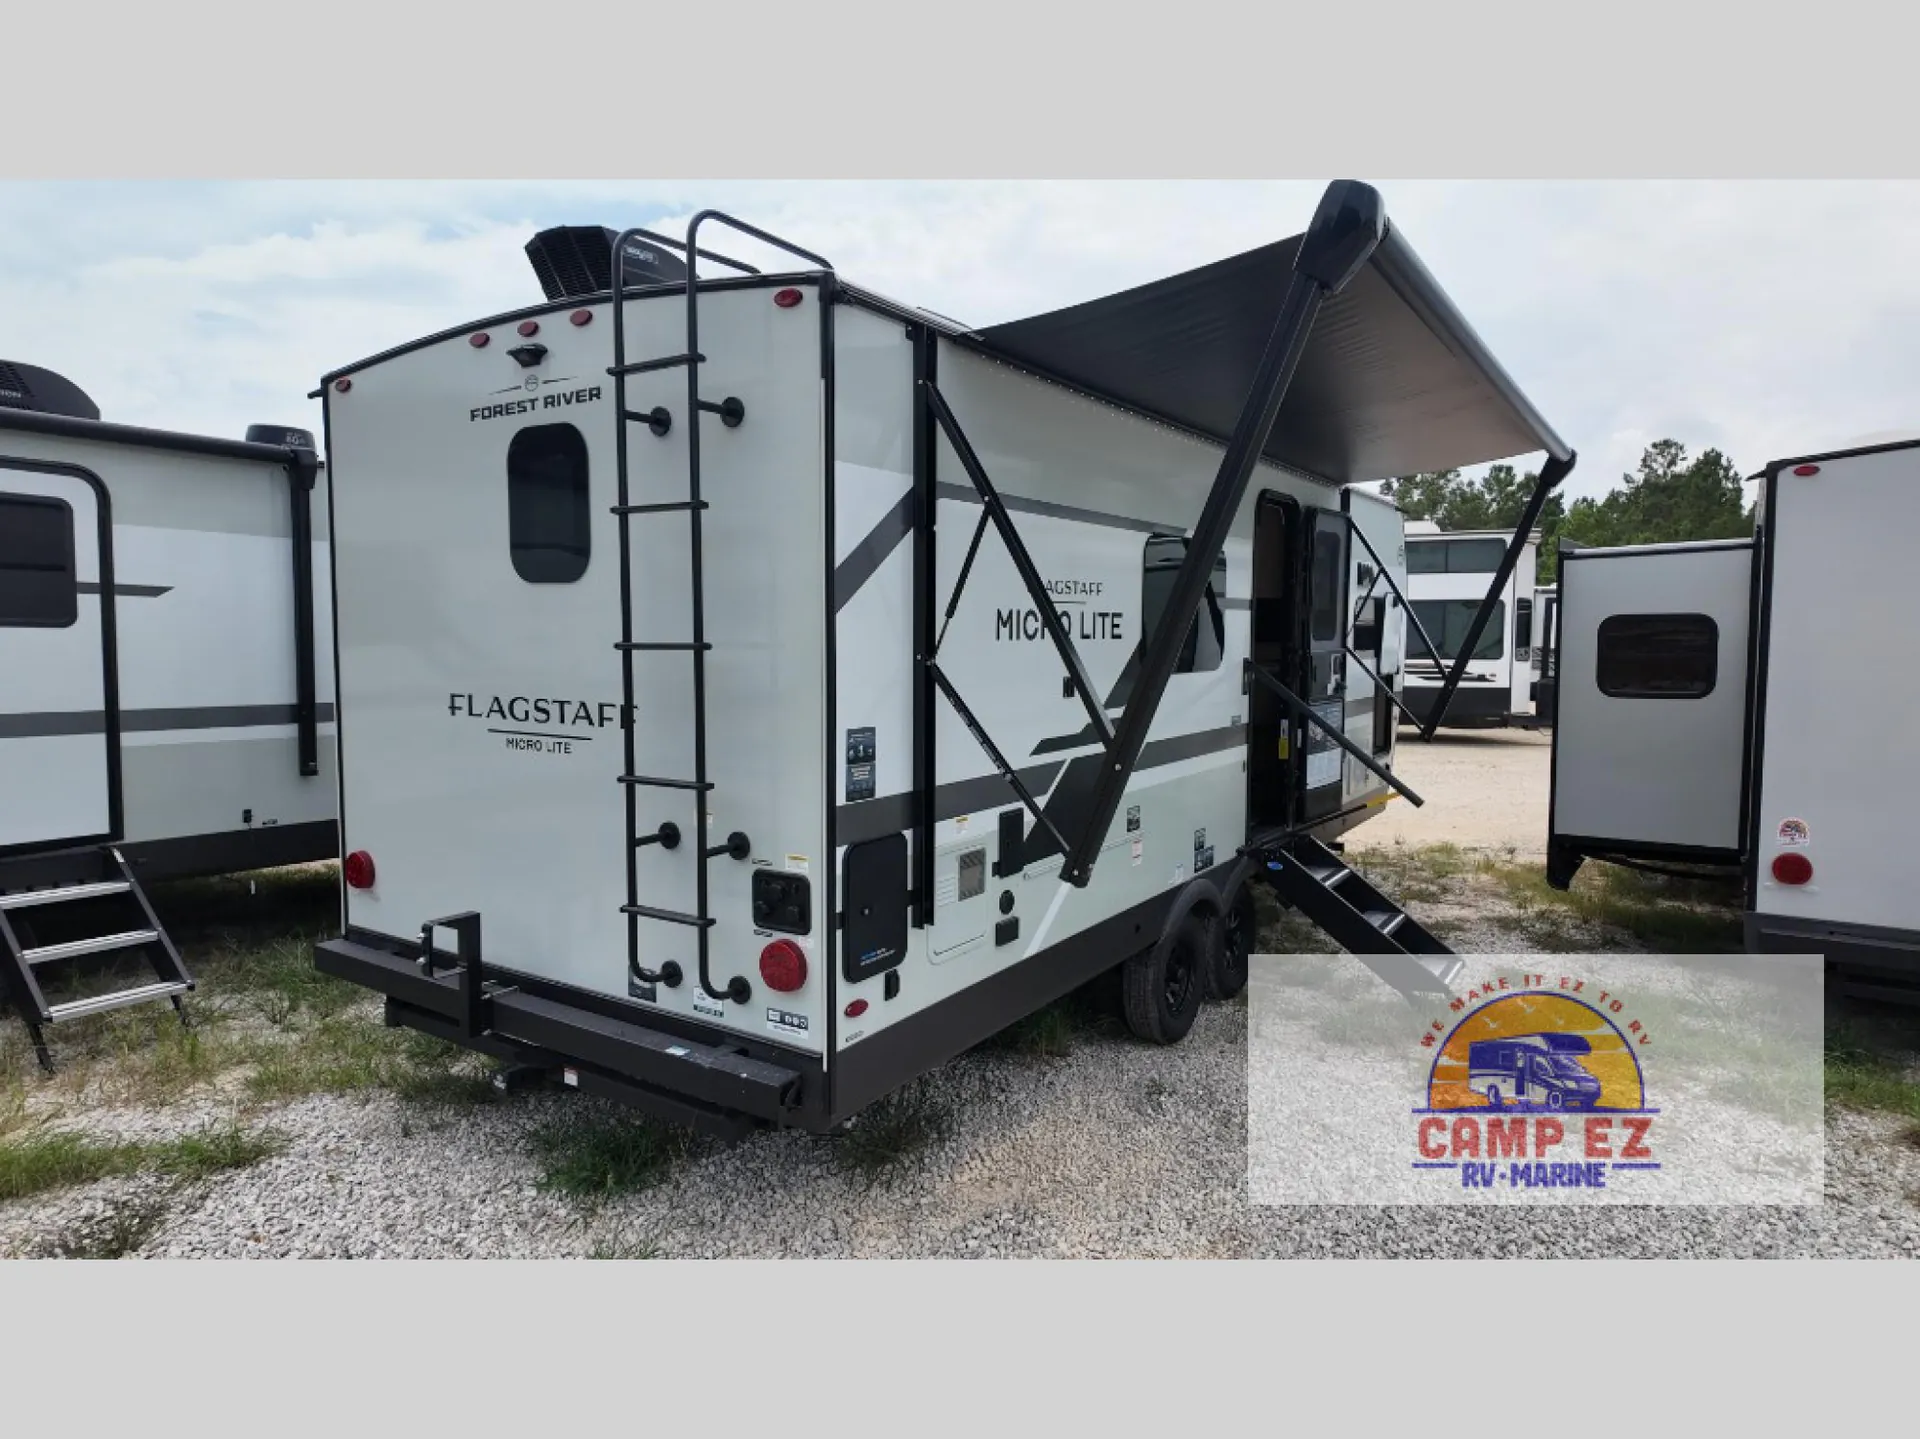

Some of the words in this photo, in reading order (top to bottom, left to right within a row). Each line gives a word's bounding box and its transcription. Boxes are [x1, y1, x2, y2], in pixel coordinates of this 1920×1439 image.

[470, 397, 539, 422] FOREST
[543, 386, 602, 409] RIVER
[1045, 580, 1103, 596] AGSTAFF
[1080, 611, 1123, 640] LITE
[506, 737, 543, 752] MICRO
[547, 741, 573, 754] LITE
